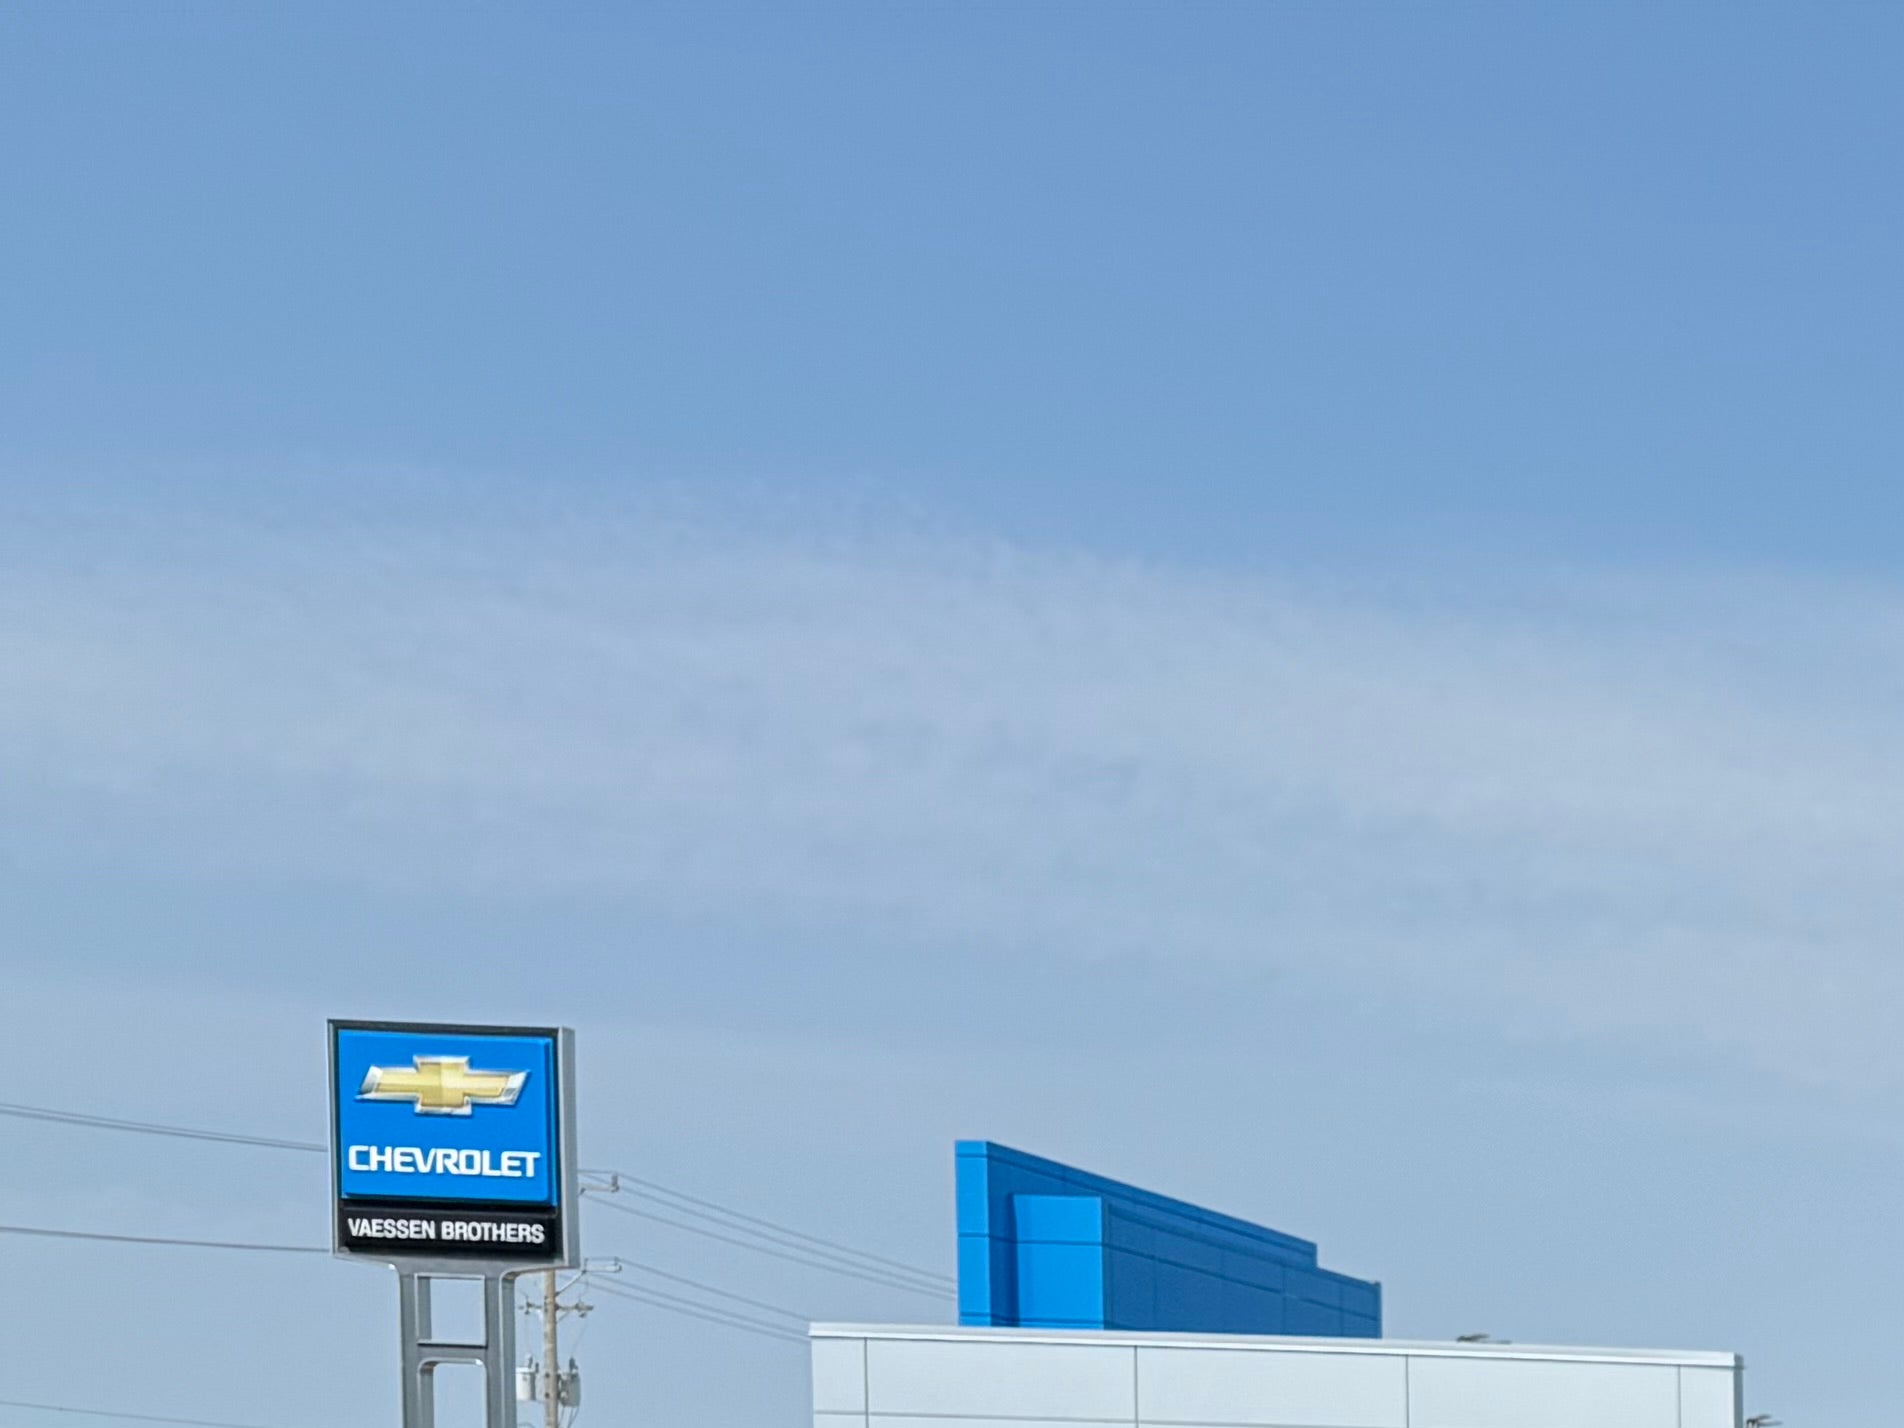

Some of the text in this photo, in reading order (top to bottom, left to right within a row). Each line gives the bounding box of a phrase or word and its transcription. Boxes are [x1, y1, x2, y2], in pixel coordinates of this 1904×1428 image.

[348, 1145, 541, 1177] CHEVROLET
[348, 1218, 545, 1243] VAESSEN BROTHERS
